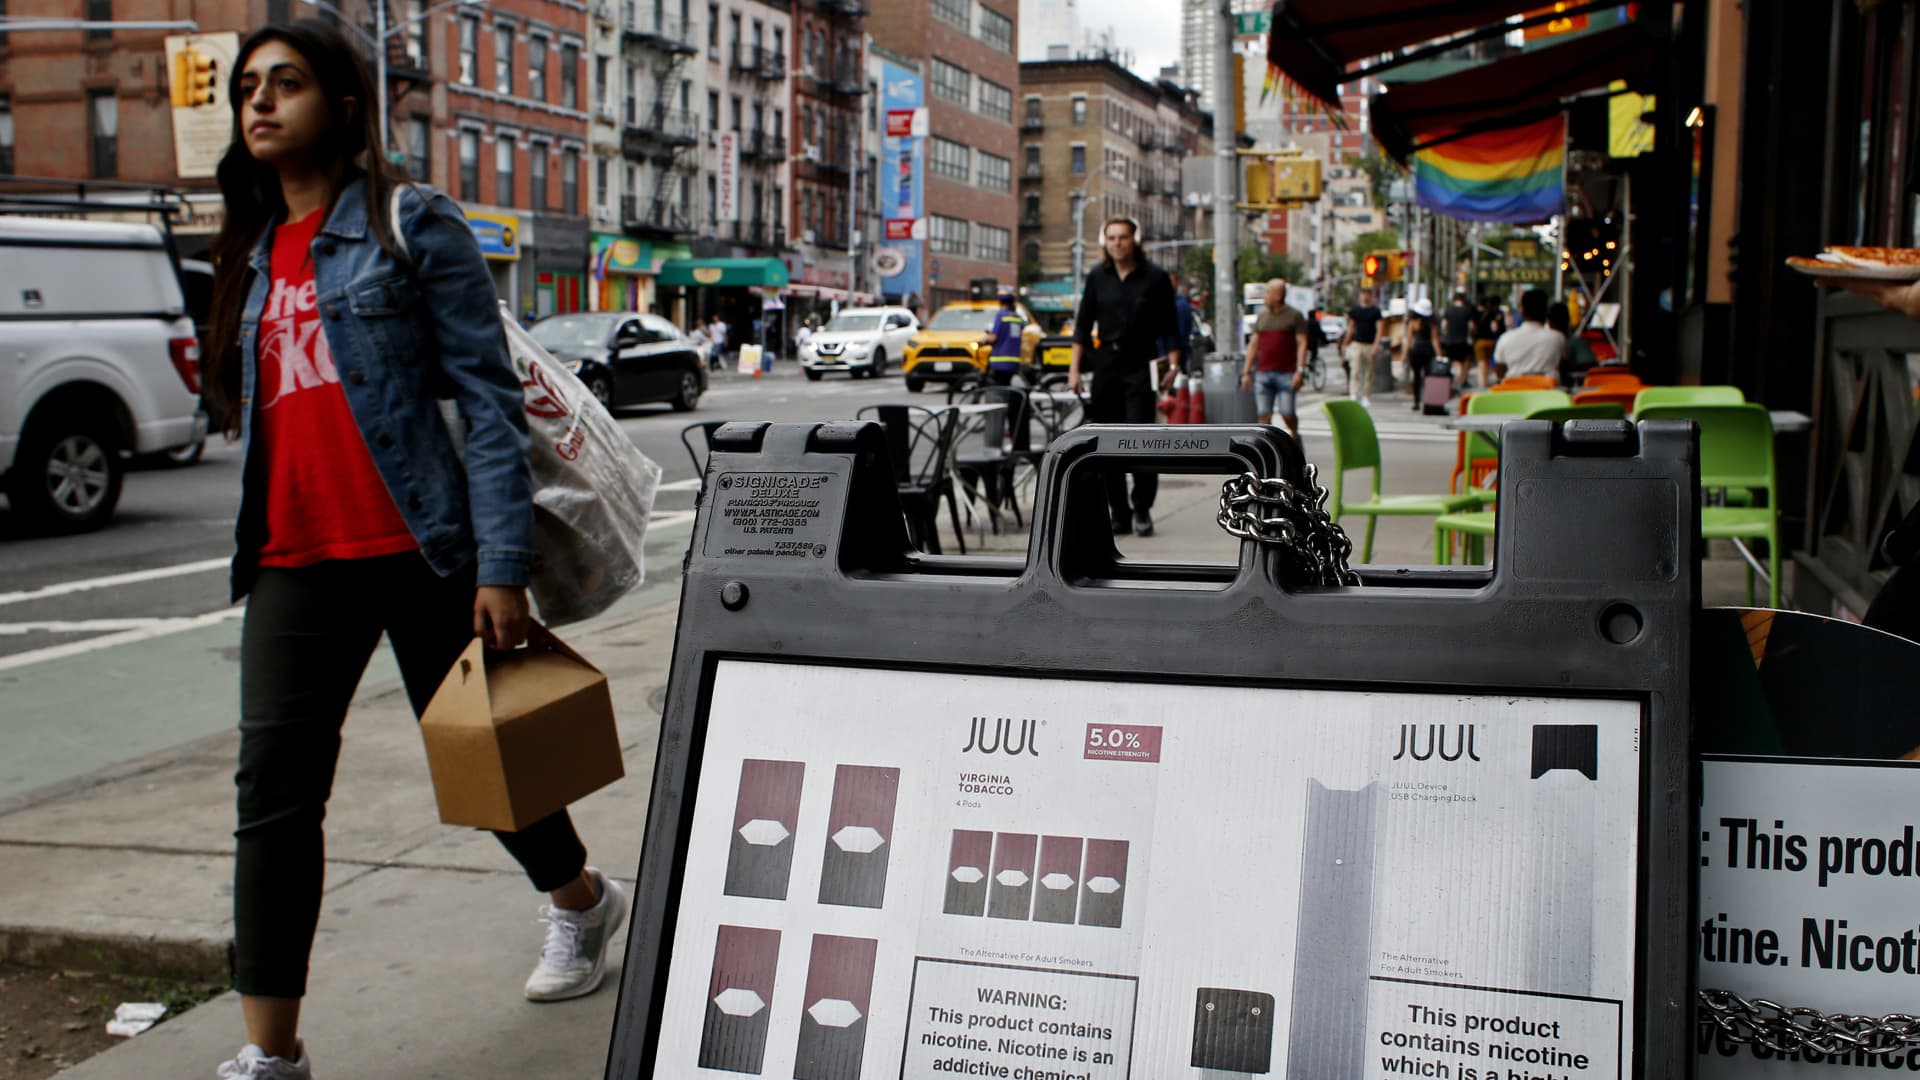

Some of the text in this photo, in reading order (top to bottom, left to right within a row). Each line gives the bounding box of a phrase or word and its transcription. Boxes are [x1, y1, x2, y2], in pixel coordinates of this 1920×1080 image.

[262, 278, 317, 321] he
[1118, 439, 1210, 450] FILL WITH SAND
[750, 489, 800, 499] DELUXE
[724, 508, 820, 518] WWW.PLASTICADE.COM
[760, 526, 794, 535] PATENTS
[724, 547, 807, 558] other patents pending
[962, 716, 1040, 757] JUUL
[1089, 728, 1141, 749] 5.0%
[1392, 723, 1482, 762] JUUL
[1087, 748, 1151, 759] NICOTINE STRENGTH
[959, 772, 1011, 785] VIRGINIA
[1391, 781, 1449, 791] JUUL Device
[958, 782, 1014, 796] TOBACCO
[1391, 792, 1477, 804] USB Charging Dock
[955, 799, 982, 809] 4 Pods
[1719, 817, 1808, 872] This
[1818, 825, 1920, 888] prod
[960, 947, 1094, 968] The Alternative For Adult Smokers
[1382, 951, 1450, 966] The Alternative
[1381, 963, 1464, 979] For Adult Smokers
[977, 987, 1068, 1012] WARNING:
[928, 1006, 1113, 1040] This product contains
[1407, 1003, 1561, 1039] This product
[921, 1031, 1114, 1066] nicotine. Nicotine is an
[1380, 1030, 1590, 1070] contains nicotine
[932, 1056, 1009, 1078] addictive
[1381, 1055, 1450, 1080] which
[1457, 1062, 1479, 1080] is
